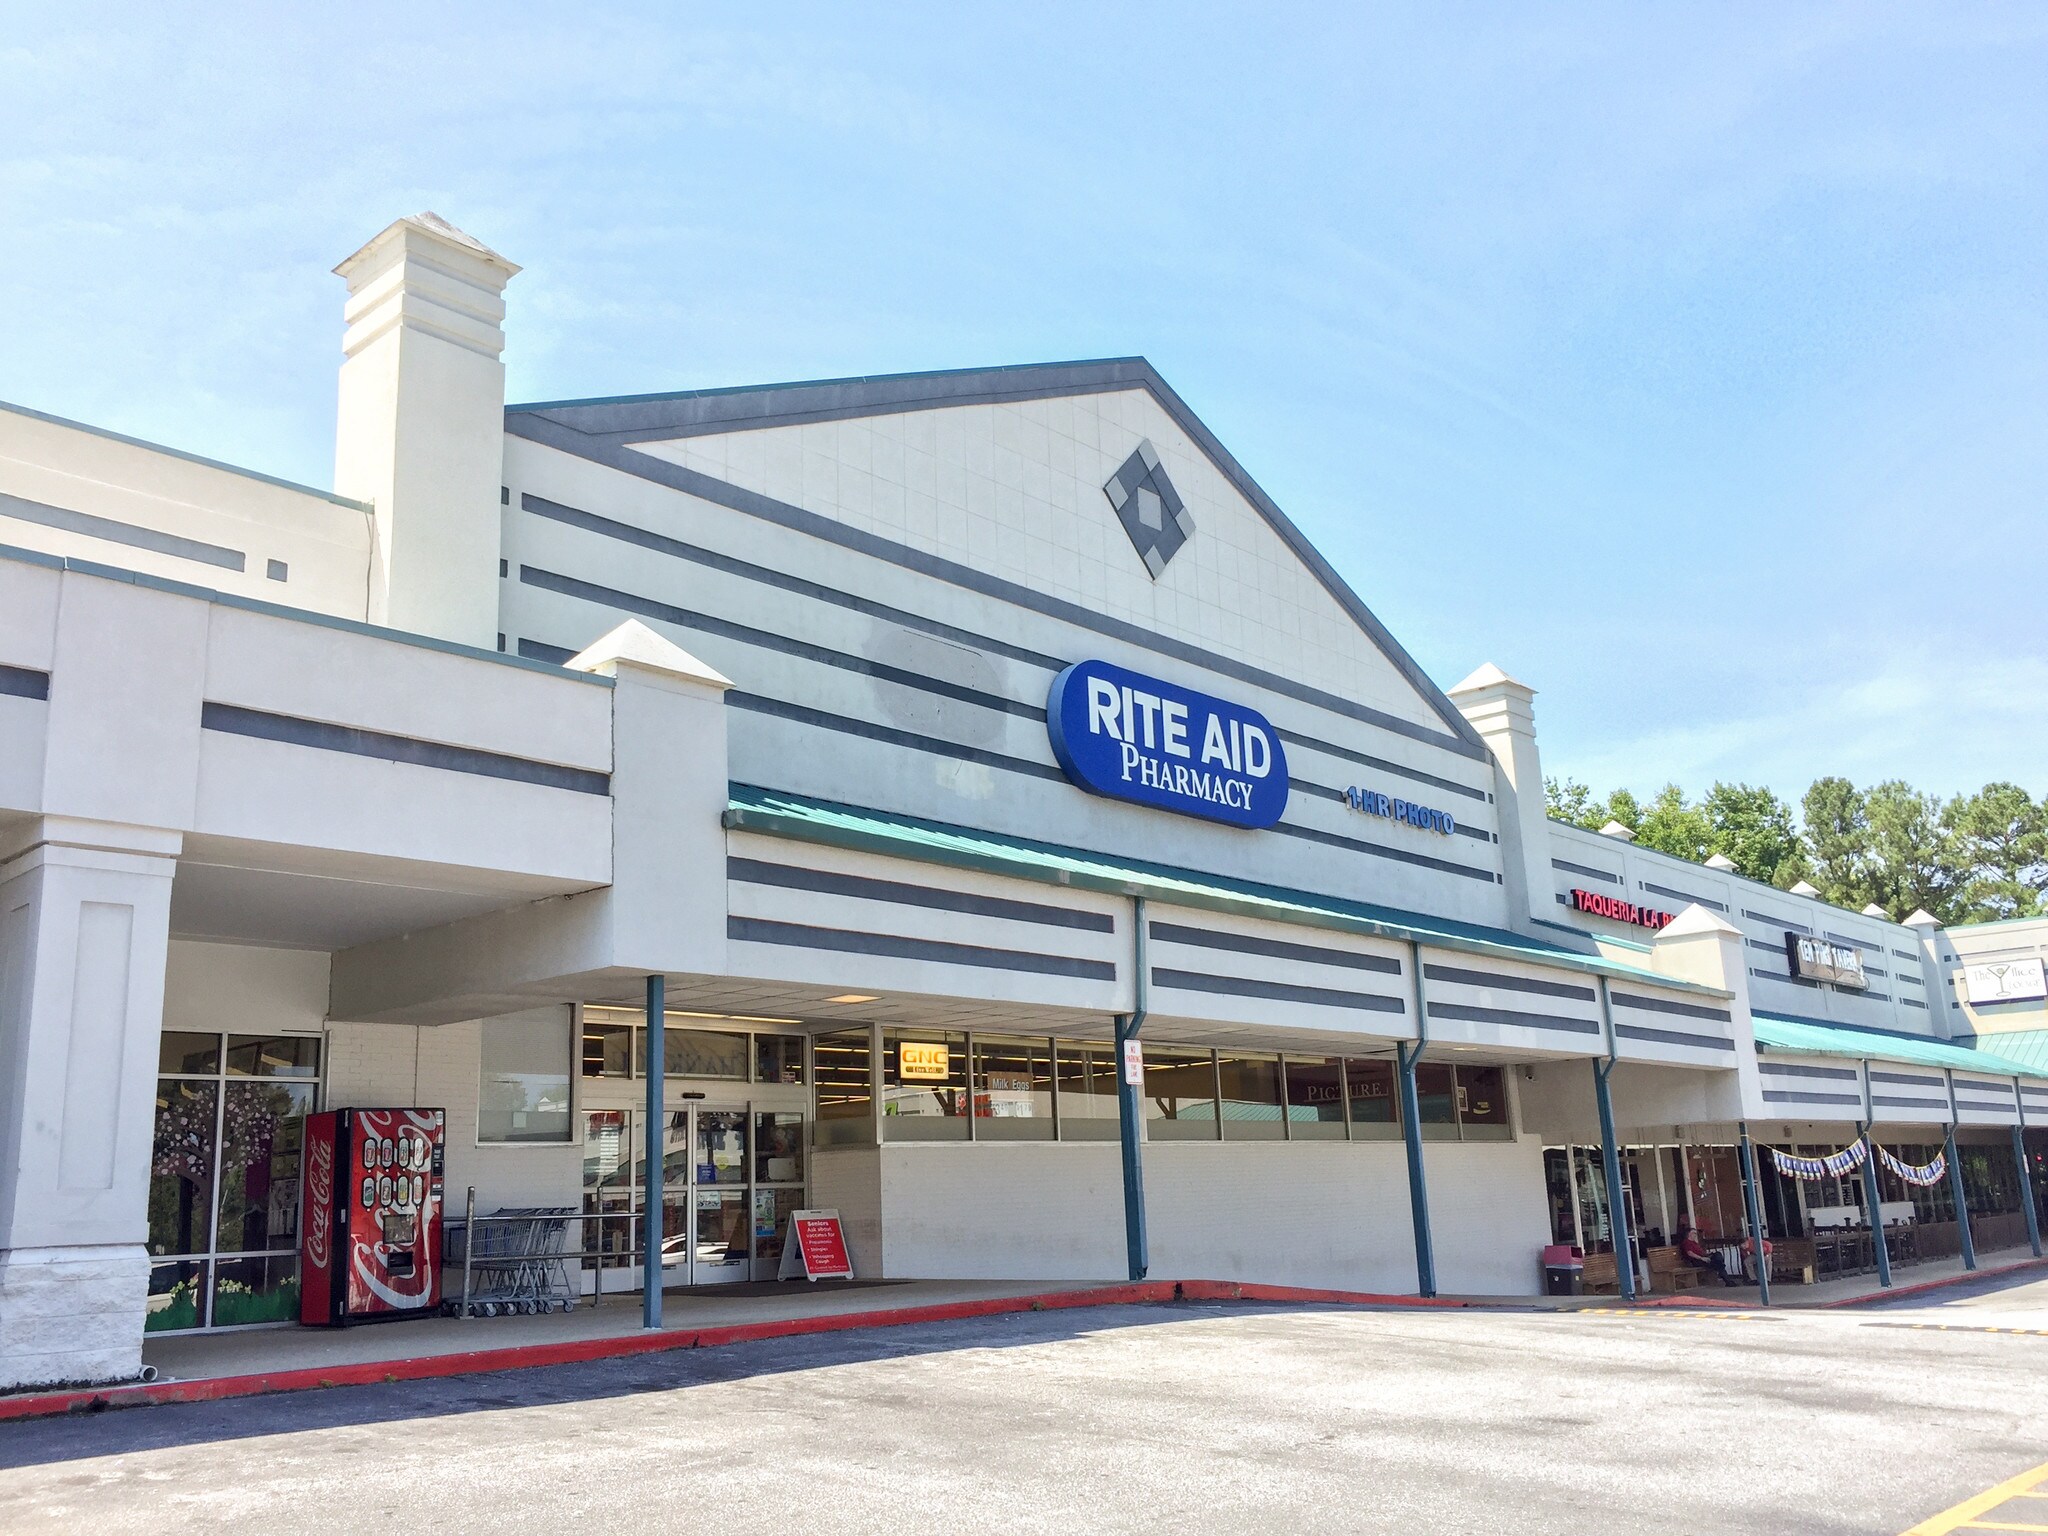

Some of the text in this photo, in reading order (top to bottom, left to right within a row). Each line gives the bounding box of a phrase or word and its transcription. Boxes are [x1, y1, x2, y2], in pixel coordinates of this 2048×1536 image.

[1087, 675, 1272, 779] RITE AID
[1119, 741, 1254, 811] PHARMACY
[1393, 798, 1455, 836] PHOTO
[1574, 888, 1640, 925] TAQUERIA
[1642, 906, 1660, 929] LA
[1974, 969, 1991, 981] The
[902, 1049, 947, 1065] GNC
[992, 1078, 1030, 1092] Milk Eggs
[1307, 1082, 1382, 1102] PICURE
